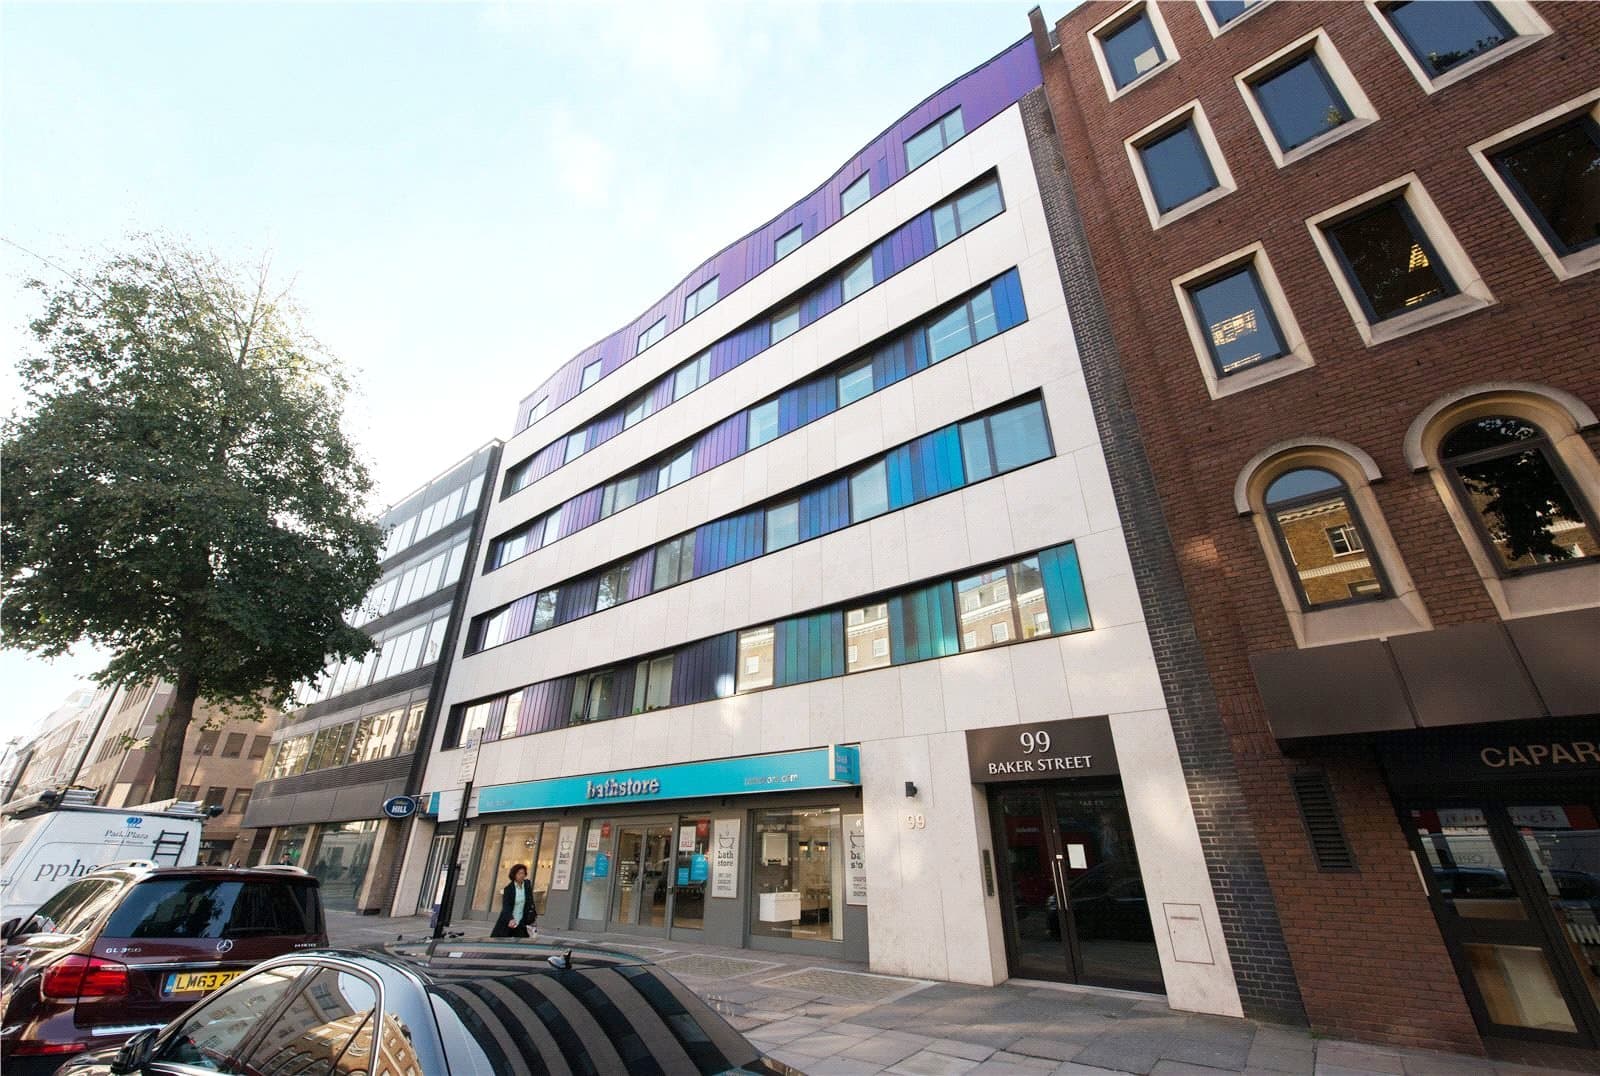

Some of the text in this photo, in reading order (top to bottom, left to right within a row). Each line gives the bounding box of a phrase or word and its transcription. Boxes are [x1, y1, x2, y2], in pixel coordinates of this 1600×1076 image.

[1020, 730, 1050, 754] 99
[1480, 741, 1600, 768] CAPAR
[988, 755, 1092, 775] BAKER STREET
[586, 778, 660, 800] bathstore
[391, 805, 408, 814] HILL
[906, 815, 926, 830] 99
[104, 829, 125, 838] Park
[717, 851, 734, 859] bath
